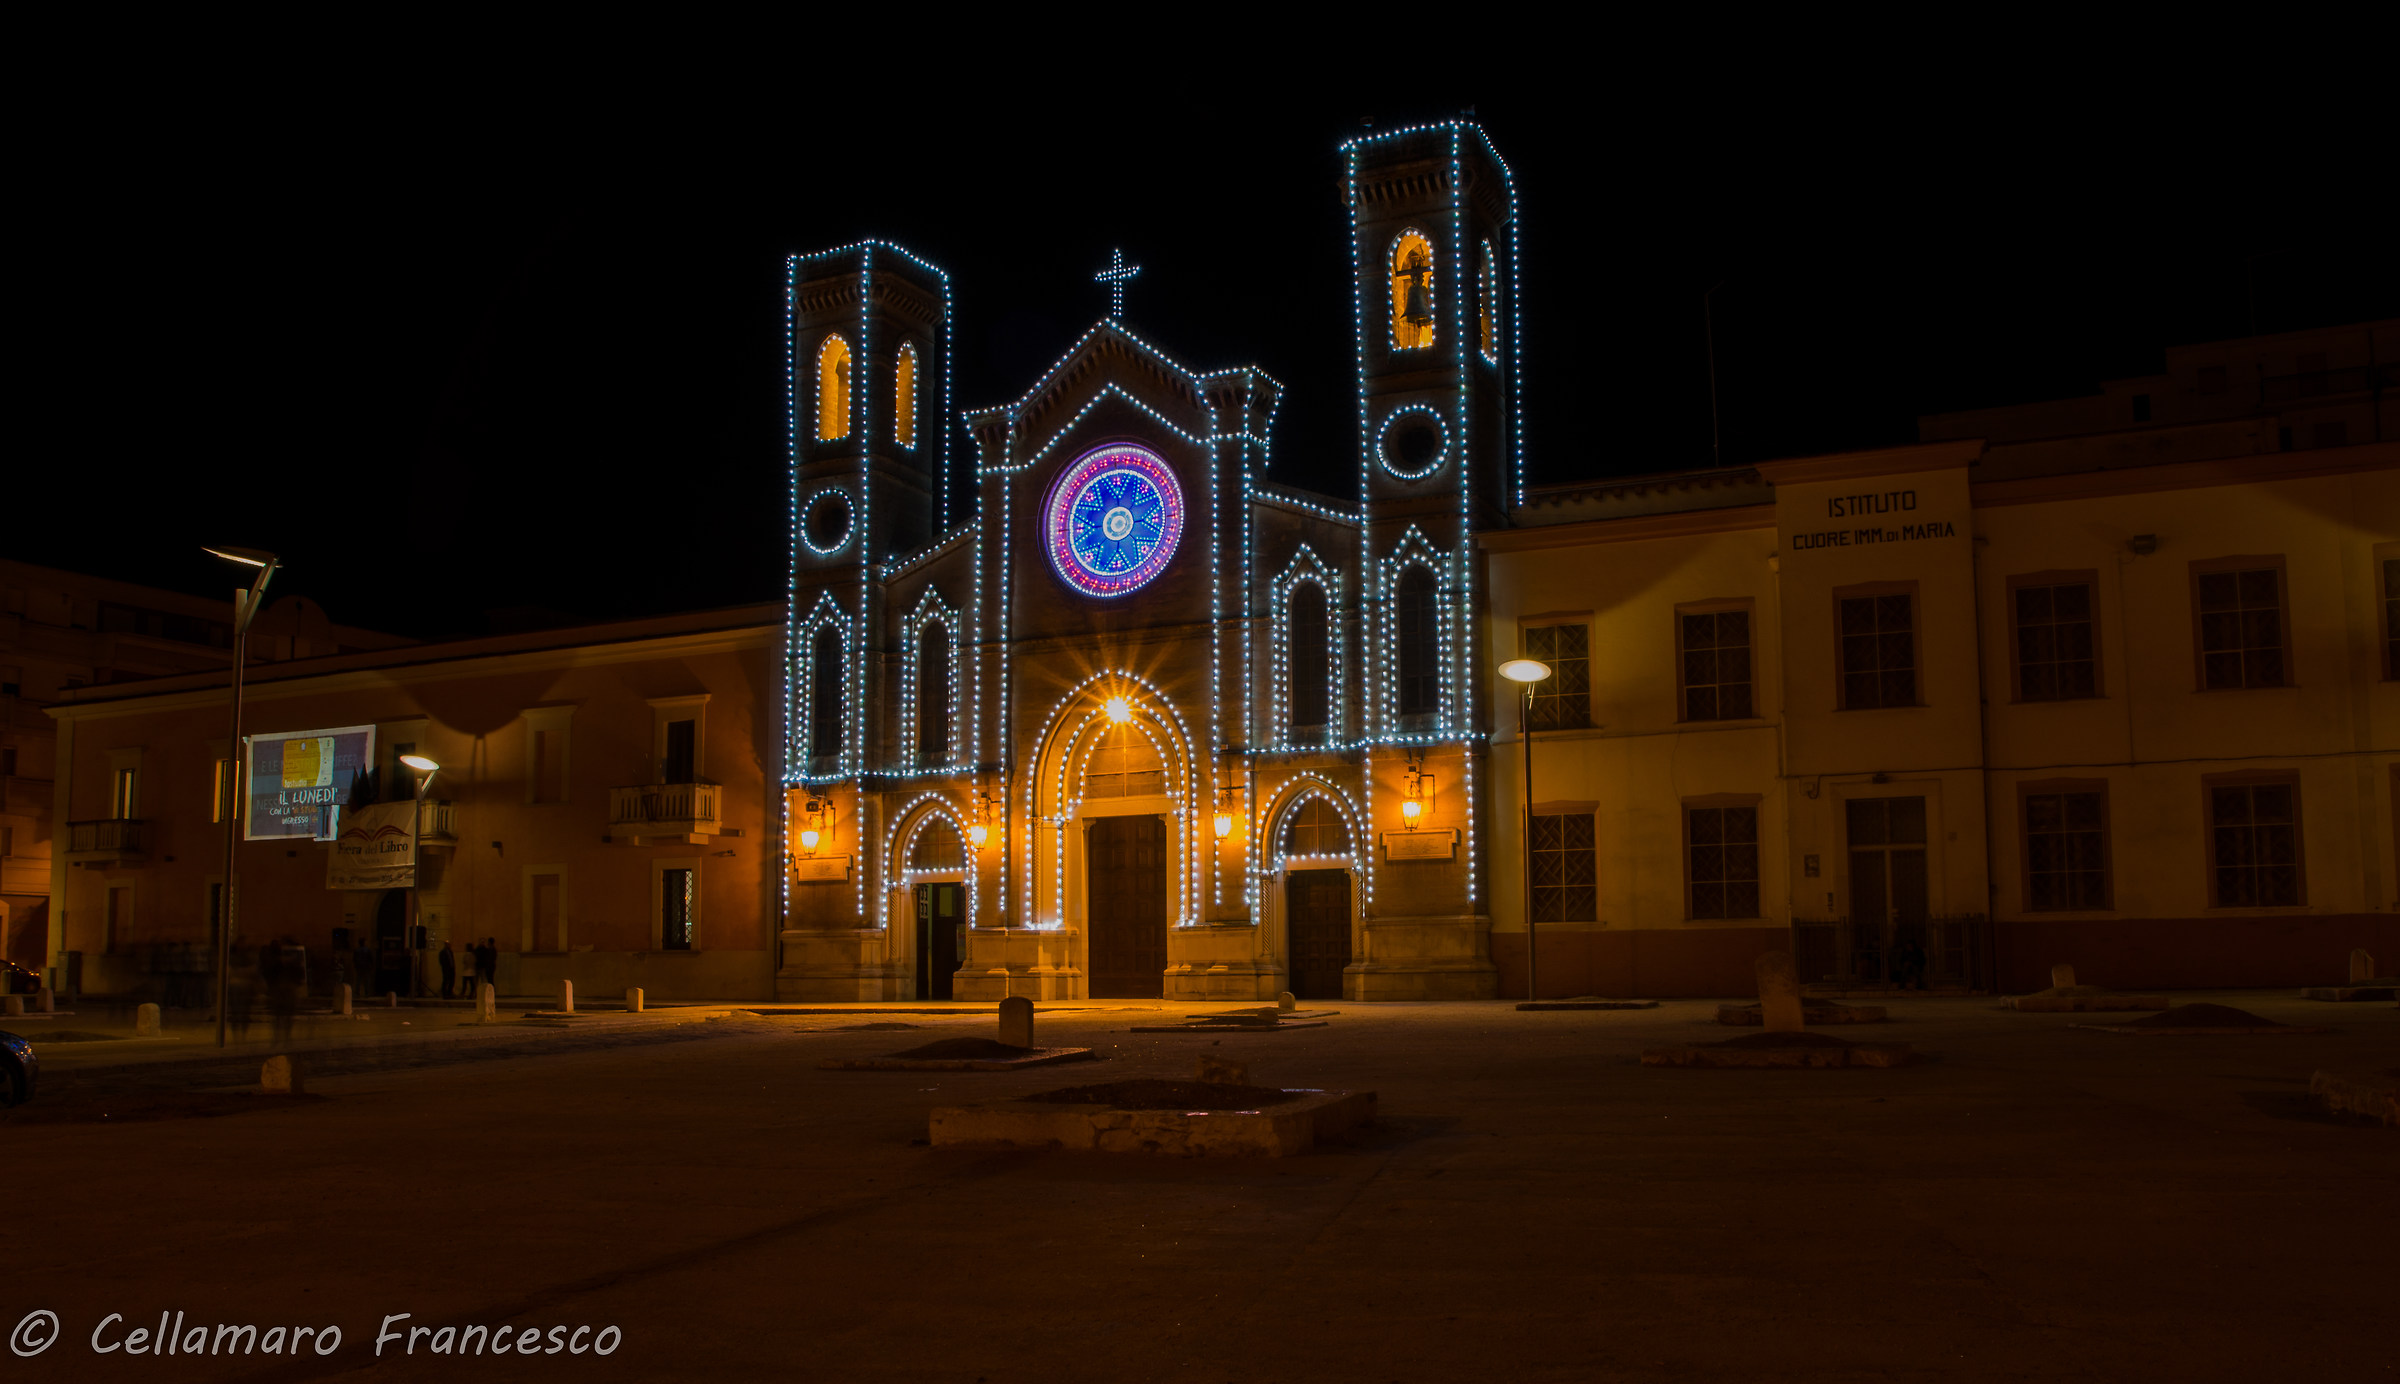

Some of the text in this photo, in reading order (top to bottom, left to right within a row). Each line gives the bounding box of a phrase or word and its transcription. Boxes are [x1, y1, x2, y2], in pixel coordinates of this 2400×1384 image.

[1828, 490, 1917, 518] ISTITUTO
[1792, 530, 1851, 550] CUORE
[1902, 521, 1955, 541] MARIA
[337, 840, 409, 855] Fiera del Libro
